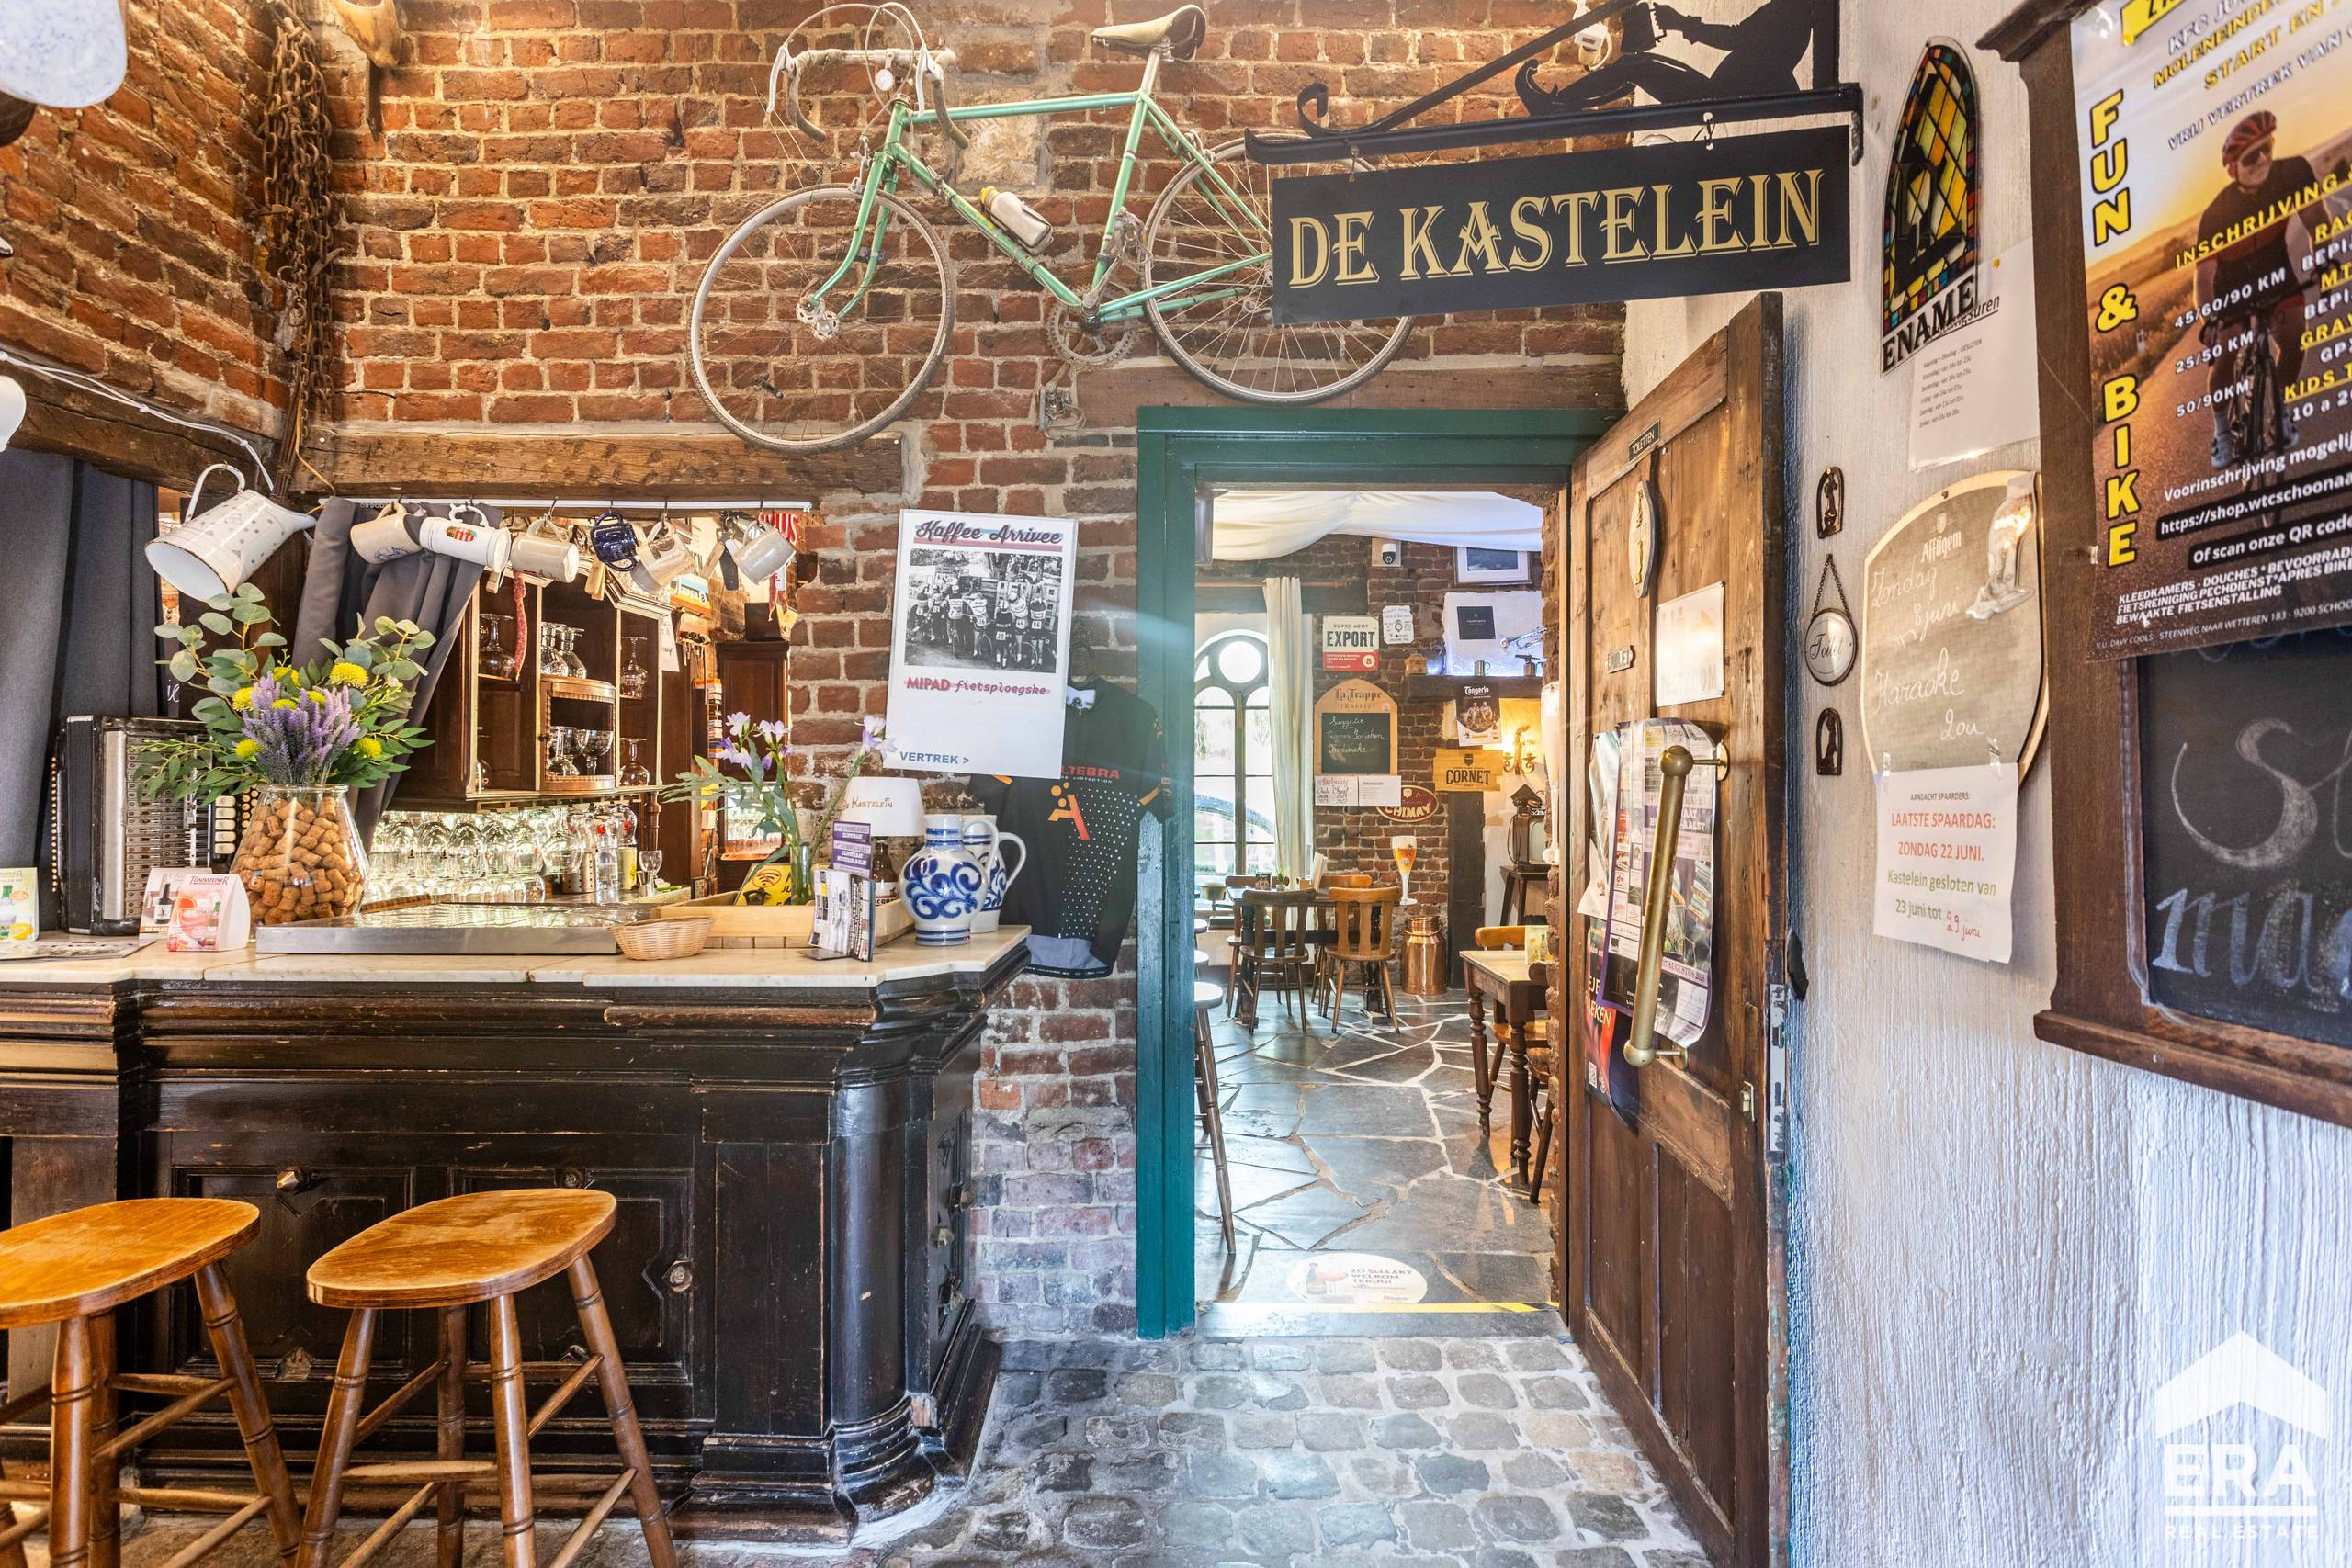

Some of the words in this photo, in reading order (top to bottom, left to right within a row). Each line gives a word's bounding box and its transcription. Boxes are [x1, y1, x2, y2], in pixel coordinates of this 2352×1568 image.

[2205, 25, 2281, 89] START
[2168, 118, 2205, 150] VRIJ
[2207, 62, 2293, 126] VERTREK
[2090, 89, 2132, 247] FUN
[1289, 211, 1380, 289] DE
[1398, 169, 1826, 281] KASTELEIN
[2176, 172, 2337, 269] INSCHRIJVING
[2096, 283, 2139, 333] &
[2175, 283, 2253, 329] 45/60/90
[2257, 267, 2286, 292] KM
[1882, 275, 1974, 374] ENAME
[2176, 344, 2222, 374] 25/50
[2227, 330, 2255, 353] KM
[2176, 378, 2250, 418] 50/90KM
[2284, 370, 2335, 402] KIDS
[2292, 401, 2315, 421] 10
[1631, 429, 1657, 456] TOILETTEN
[2103, 373, 2141, 568] BIKE
[2164, 454, 2286, 502] Voorinschrijving
[916, 520, 983, 544] Kaffee
[989, 524, 1064, 545] Arrivee
[1920, 531, 1962, 563] Affligem
[2193, 547, 2211, 563] Of
[2212, 542, 2245, 559] scan
[2248, 533, 2285, 551] onze
[2289, 524, 2312, 543] QR
[2119, 580, 2195, 604] KLEEDKAMERS
[2202, 566, 2258, 588] DOUCHES
[2116, 605, 2175, 626] BEWAAKTE
[2178, 585, 2282, 614] FIETSENSTALLING
[2118, 590, 2198, 615] FIETSREINIGING
[1326, 630, 1375, 648] EXPORT
[2129, 634, 2154, 645] COOLS
[2159, 626, 2199, 640] STEENWEG
[2224, 614, 2268, 629] WETTEREN
[2293, 605, 2316, 618] 9200
[906, 677, 951, 691] MIPAD
[1873, 647, 1964, 715] Karaoke
[899, 751, 959, 765] VERTREK
[1061, 764, 1120, 779] LTEBRA
[1445, 769, 1491, 785] CORNET
[1385, 802, 1430, 818] CHIMAY
[1910, 793, 1937, 801] AANDACHT
[1938, 792, 1971, 801] SPAARDERS:
[1892, 813, 1929, 827] LAATSTE
[1931, 812, 1996, 829] SPAARDAG:
[1898, 841, 1938, 859] ZONDAG
[1940, 844, 1952, 859] 22
[1955, 845, 1984, 862] JUNI.
[1888, 869, 1928, 887] Kastelein
[1929, 874, 1974, 893] gesloten
[1977, 882, 1996, 897] van
[1895, 899, 1906, 913] 23
[1907, 903, 1926, 919] juni
[1928, 907, 1942, 920] tot
[1668, 962, 1695, 978] AUGUSTUS
